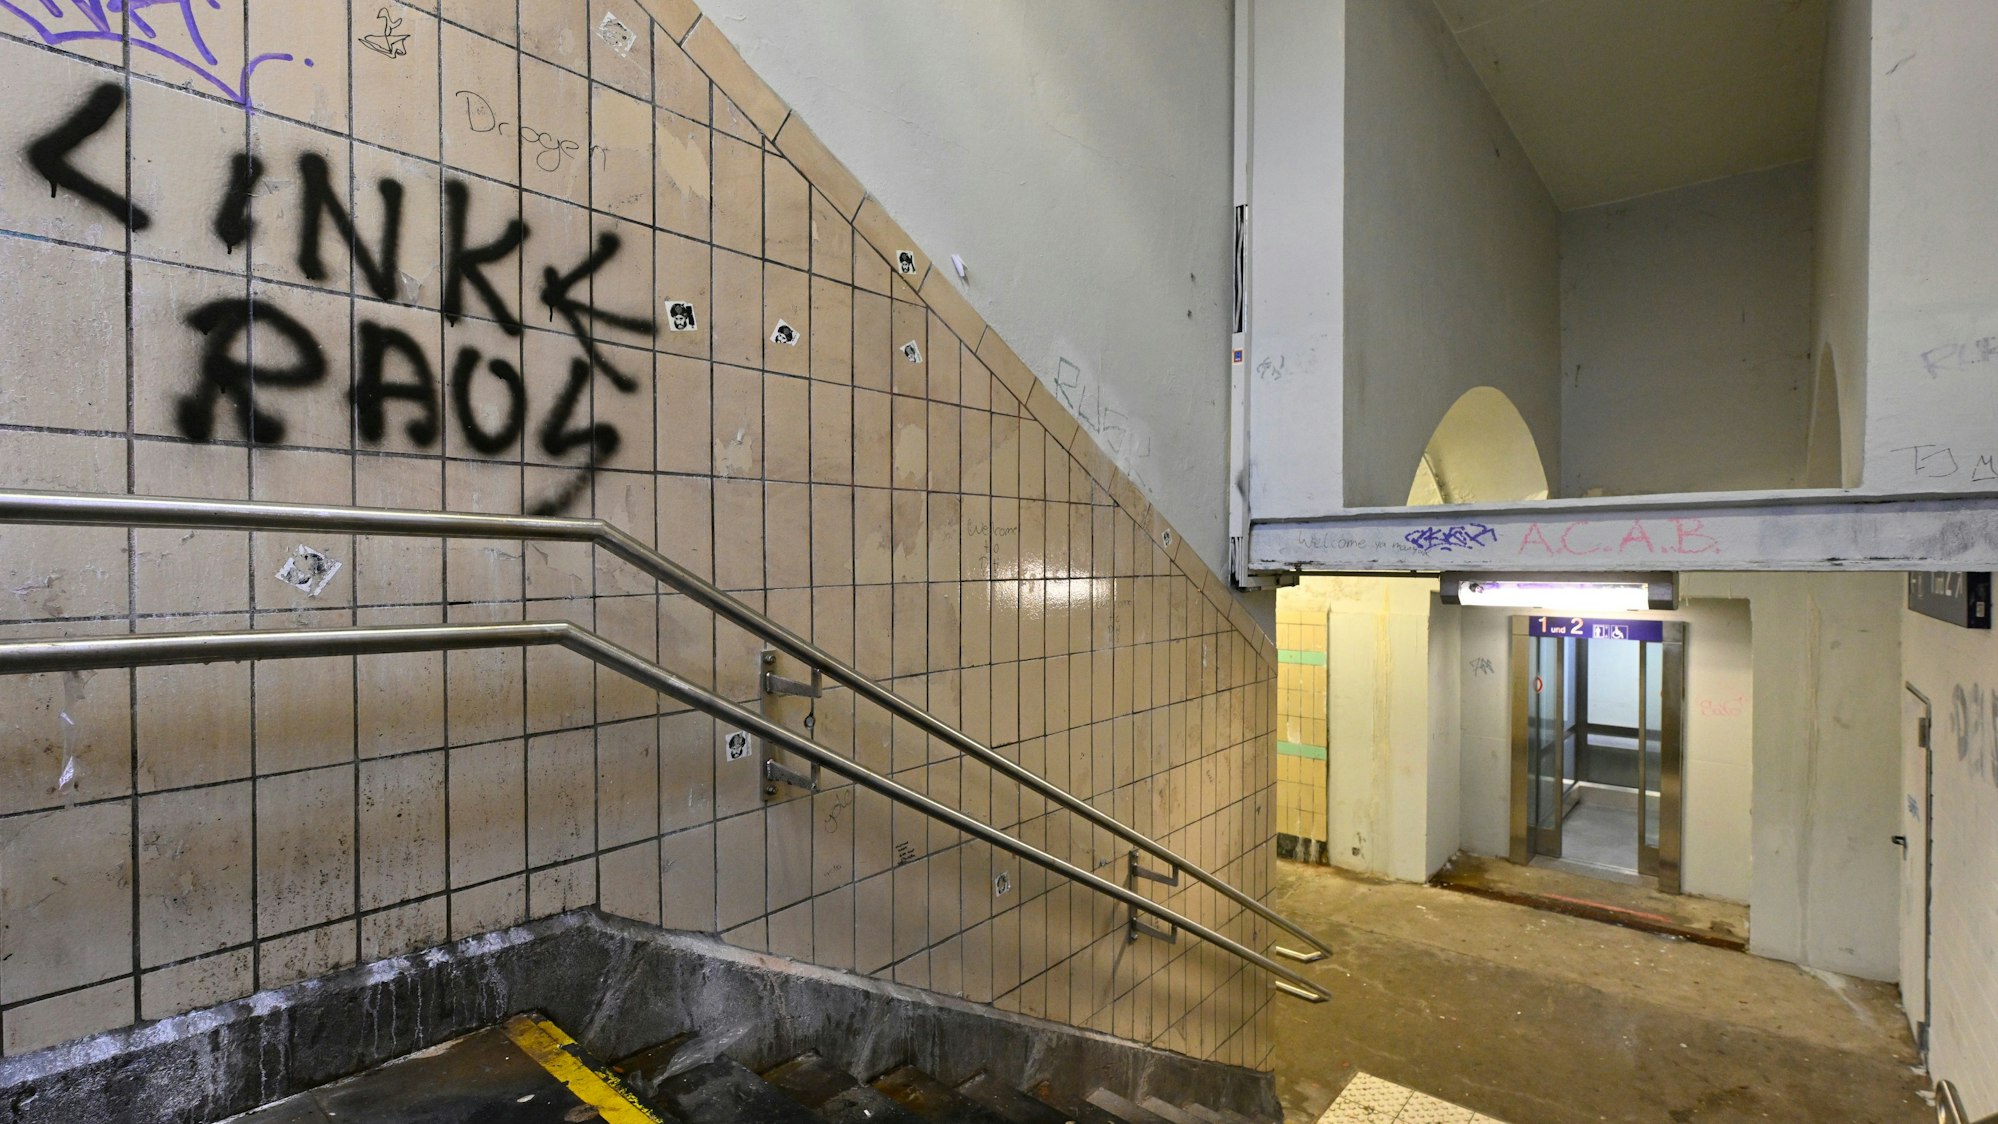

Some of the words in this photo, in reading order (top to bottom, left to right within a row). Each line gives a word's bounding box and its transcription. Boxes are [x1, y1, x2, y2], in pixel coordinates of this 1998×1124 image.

[456, 90, 608, 172] Drogen
[174, 298, 622, 518] RAUS
[1538, 616, 1547, 633] 1
[1551, 625, 1566, 634] und
[1570, 617, 1584, 635] 2
